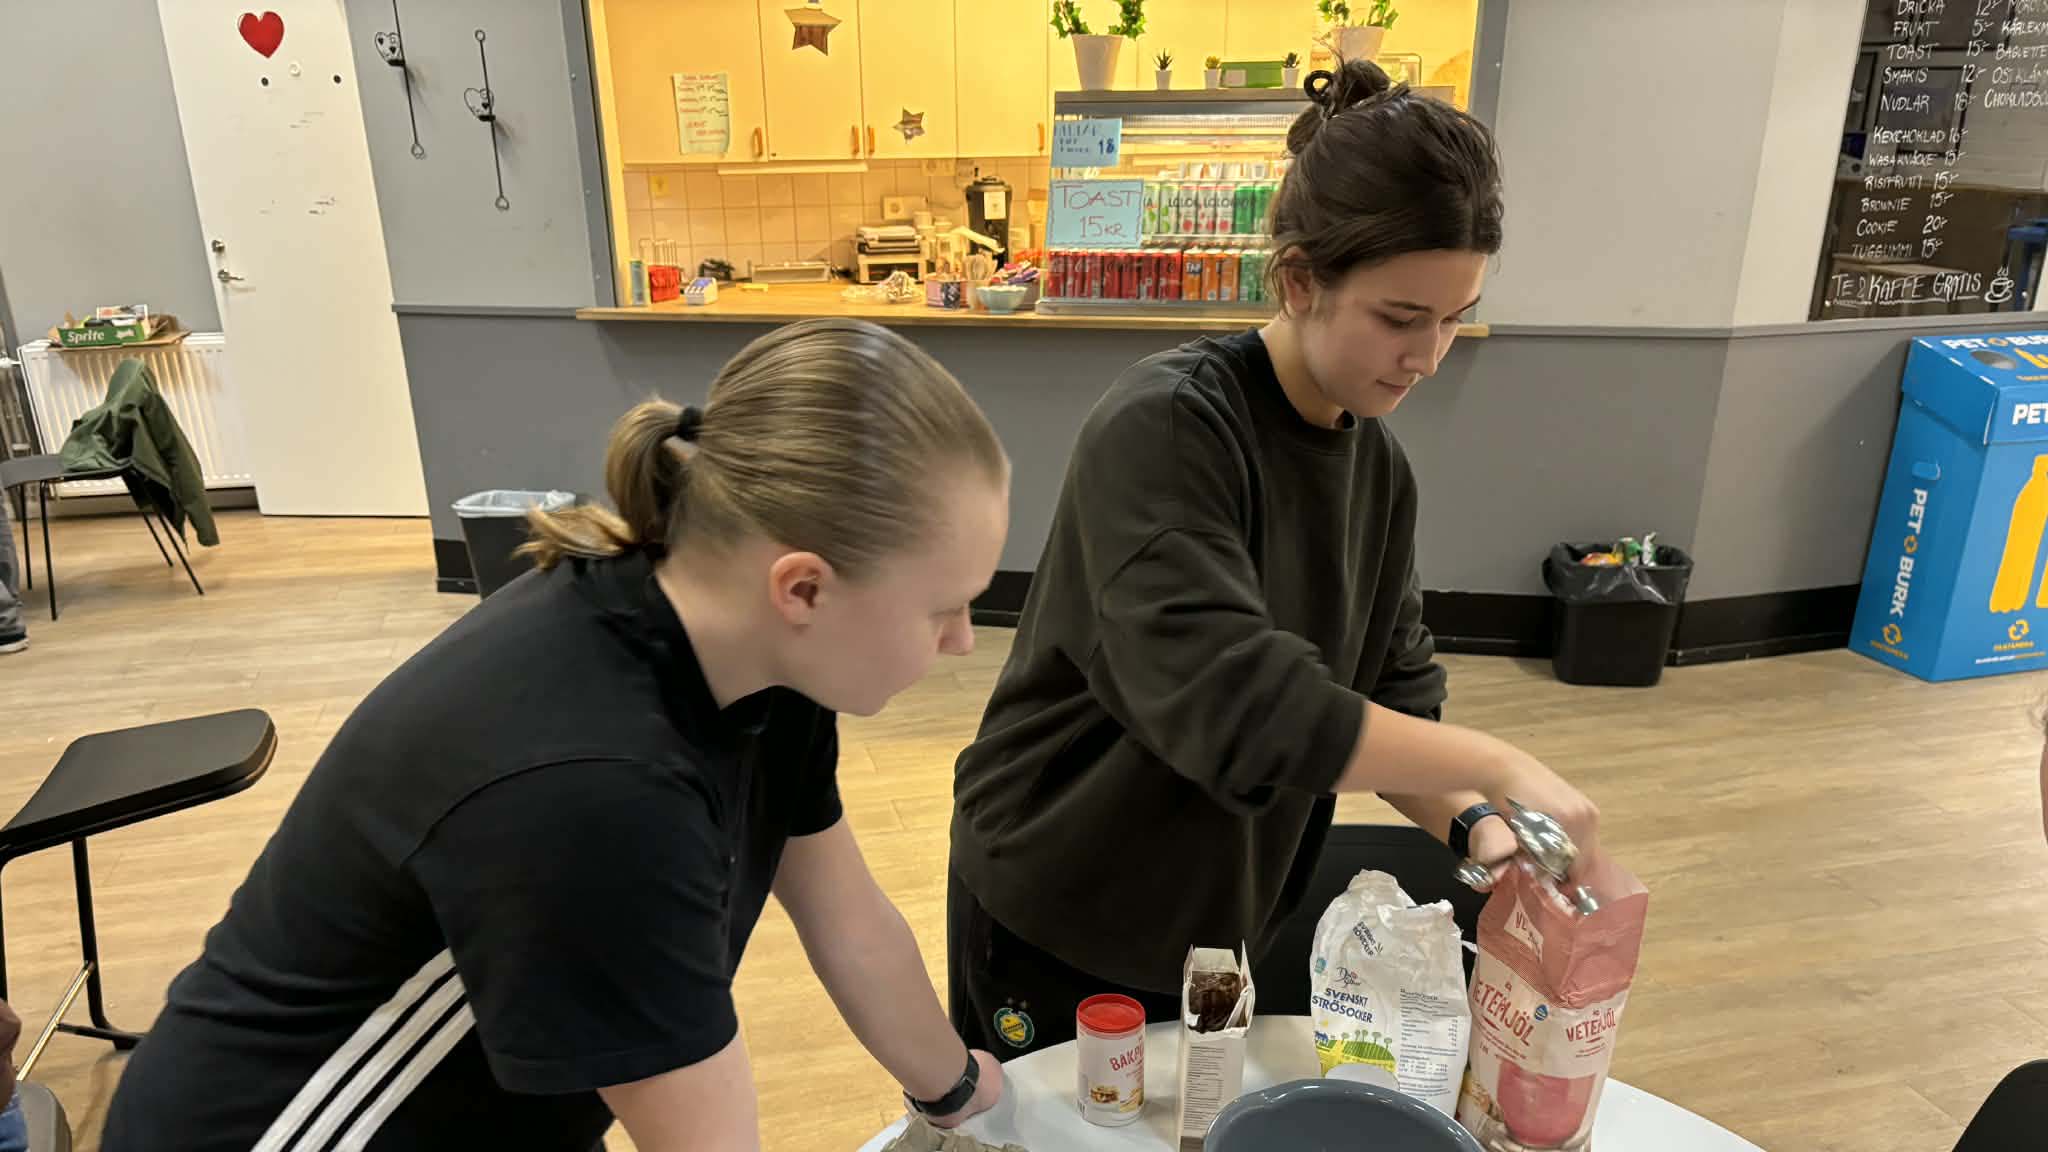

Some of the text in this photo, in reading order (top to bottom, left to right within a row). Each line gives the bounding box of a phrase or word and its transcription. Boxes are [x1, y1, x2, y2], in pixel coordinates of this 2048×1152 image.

[1897, 0, 1946, 16] DRICKA
[1893, 21, 1940, 37] FRUKT
[1887, 43, 1940, 61] TOAST
[1883, 66, 1929, 86] SMAKIS
[1880, 93, 1930, 114] NUDLAR
[1873, 126, 1946, 144] KEXCHOKLAD
[1055, 185, 1142, 209] TOAST
[1861, 197, 1912, 213] BROWNIE
[1856, 219, 1898, 236] COOKIE
[1832, 274, 1854, 298] TE
[1868, 275, 1928, 302] KAFFE
[1933, 272, 1982, 302] GRATIS
[67, 330, 105, 344] Sprite
[1908, 488, 1929, 534] PET
[1889, 556, 1915, 618] BURK
[1324, 988, 1369, 1008] SVENSKT
[1312, 995, 1373, 1023] STRÖSOCKER
